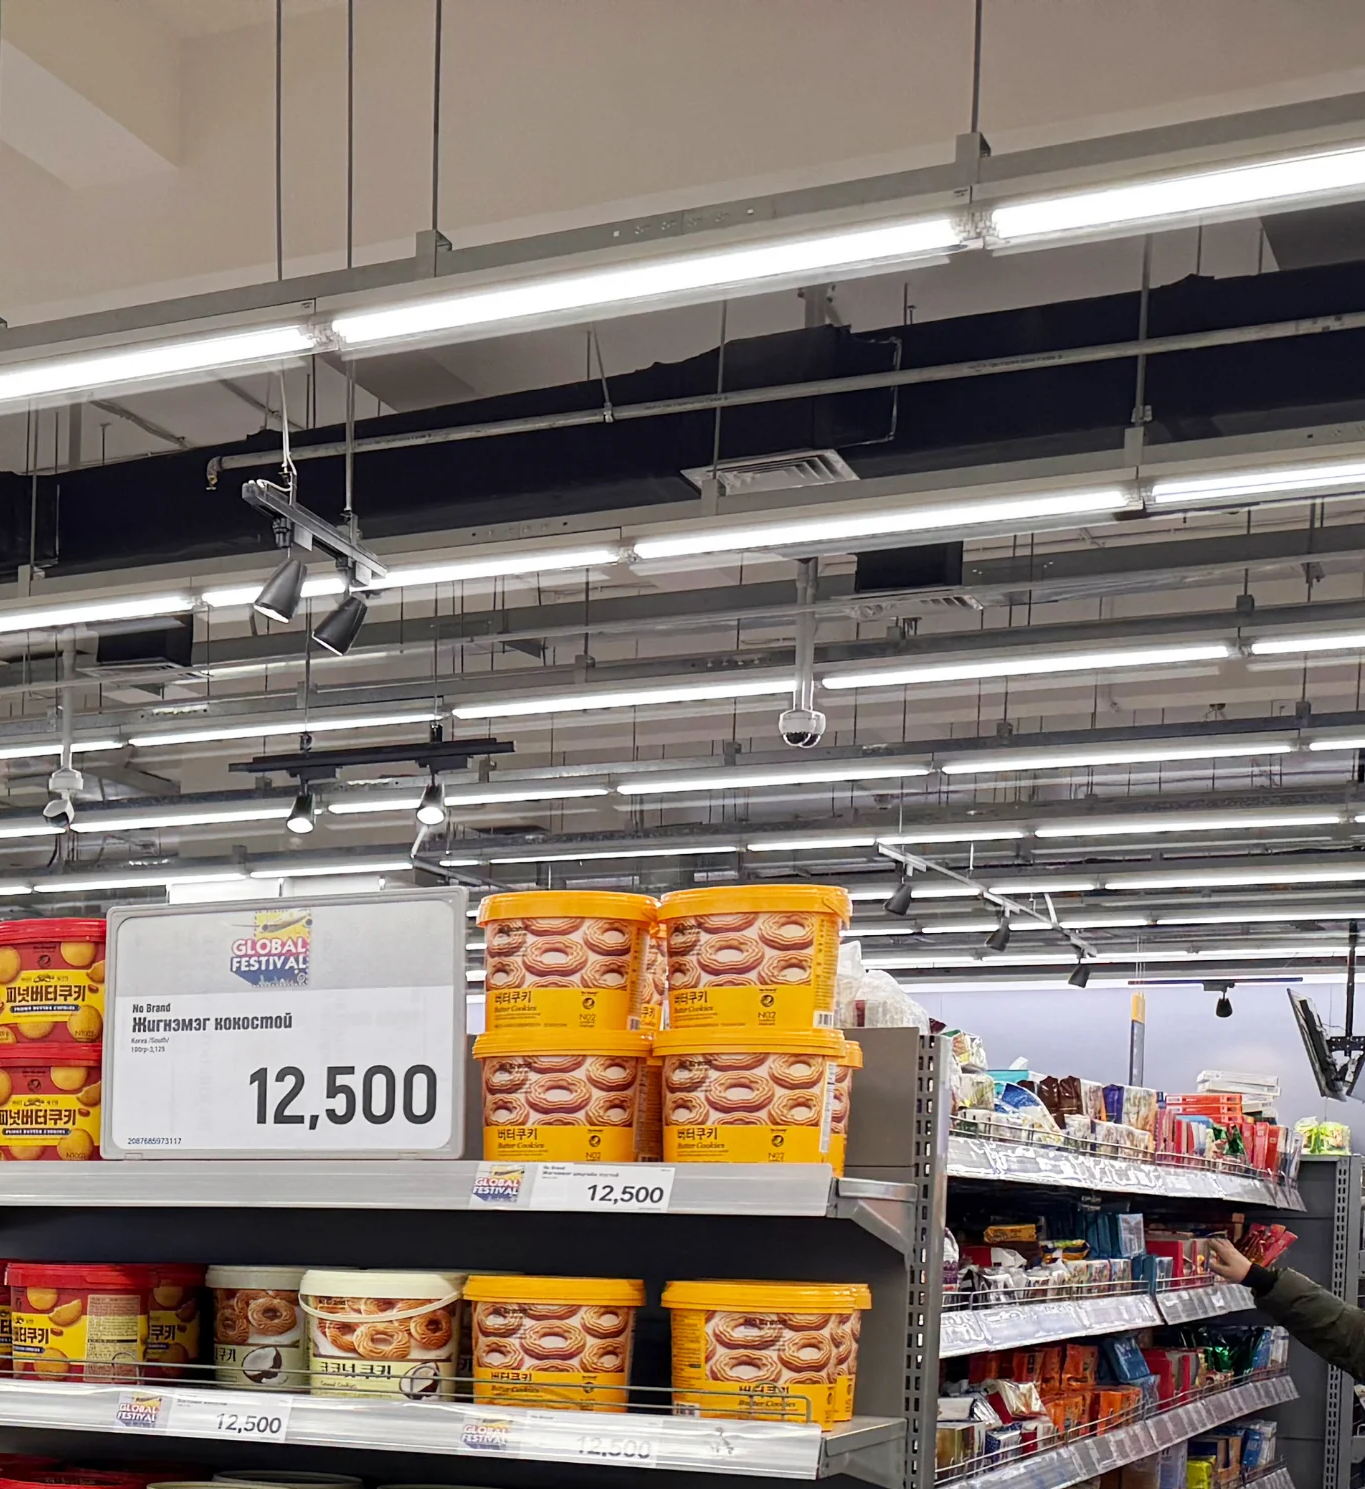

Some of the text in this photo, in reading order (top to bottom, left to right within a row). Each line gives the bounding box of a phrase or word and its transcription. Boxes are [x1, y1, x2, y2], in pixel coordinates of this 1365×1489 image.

[232, 937, 308, 957] GLOBAL
[231, 954, 308, 972] FESTIVAL
[5, 984, 86, 1003] 피넛버터쿠키
[494, 991, 533, 1005] 버터쿠키
[673, 991, 709, 1005] 버터쿠키
[132, 1003, 171, 1014] No Brand
[132, 1016, 211, 1033] Жигнэмэг
[249, 1064, 438, 1130] 12,500
[497, 1128, 539, 1142] 버터쿠키
[676, 1128, 719, 1142] 버터쿠키
[473, 1178, 519, 1188] GLOBAL
[587, 1184, 663, 1204] 12,500
[215, 1411, 282, 1435] 12,500
